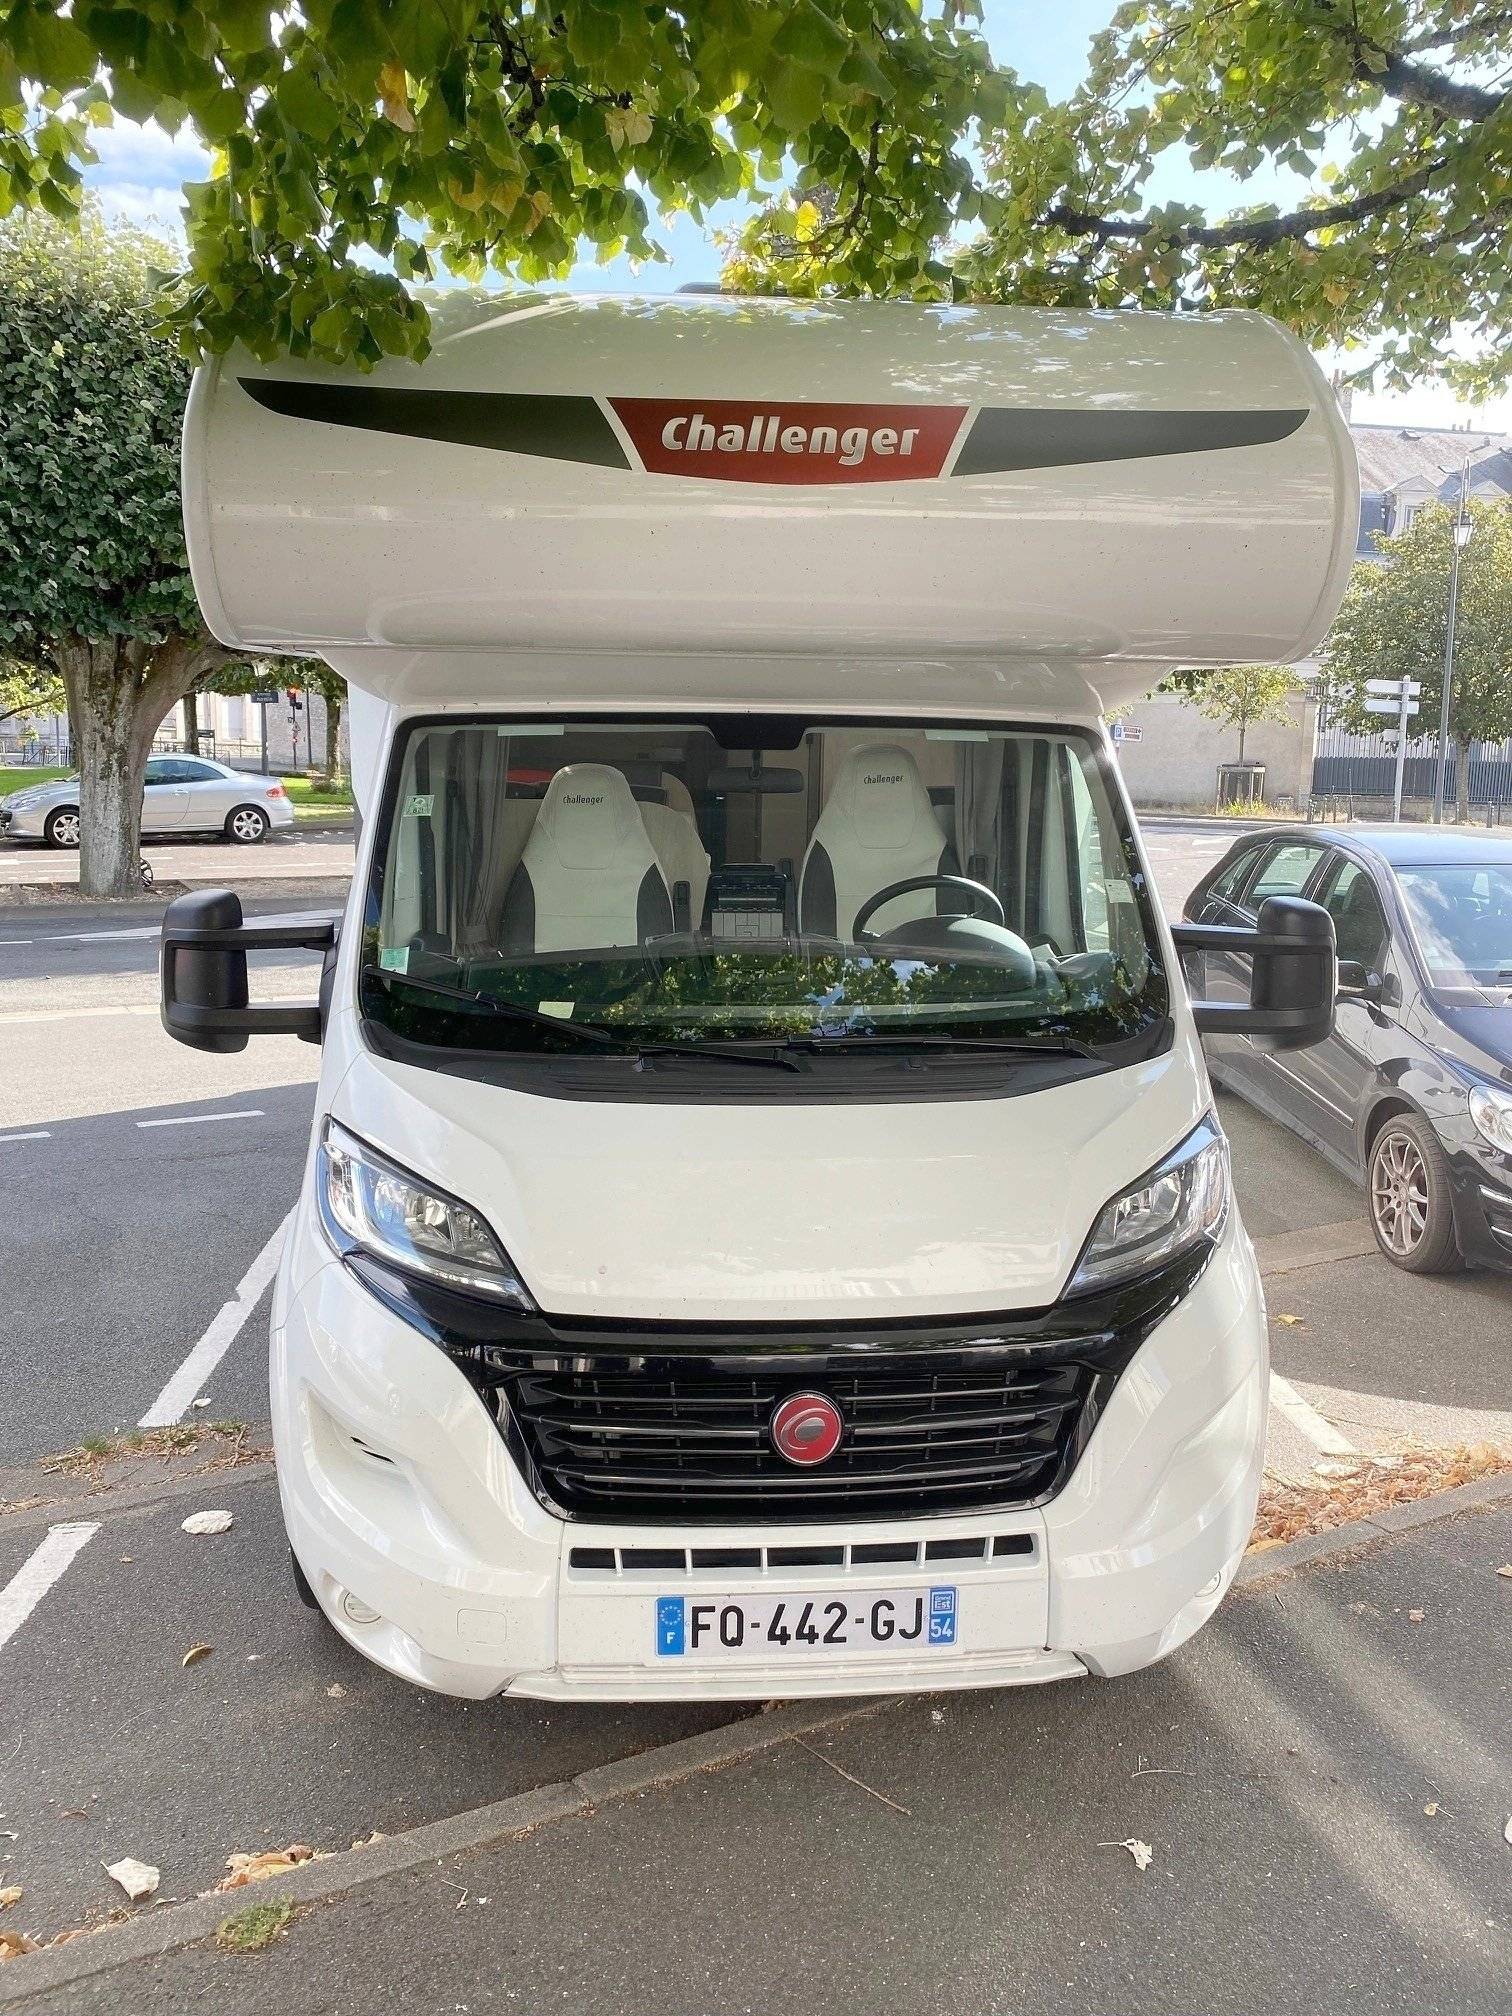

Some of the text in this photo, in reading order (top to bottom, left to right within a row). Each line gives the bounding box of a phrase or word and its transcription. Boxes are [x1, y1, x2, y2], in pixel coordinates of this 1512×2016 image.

[661, 414, 919, 466] Challenger
[863, 774, 904, 785] Challenger
[563, 794, 604, 805] Challenger
[934, 1600, 951, 1609] Est
[690, 1597, 923, 1649] FQ-442-GJ
[930, 1617, 953, 1638] 54
[666, 1631, 674, 1644] F
